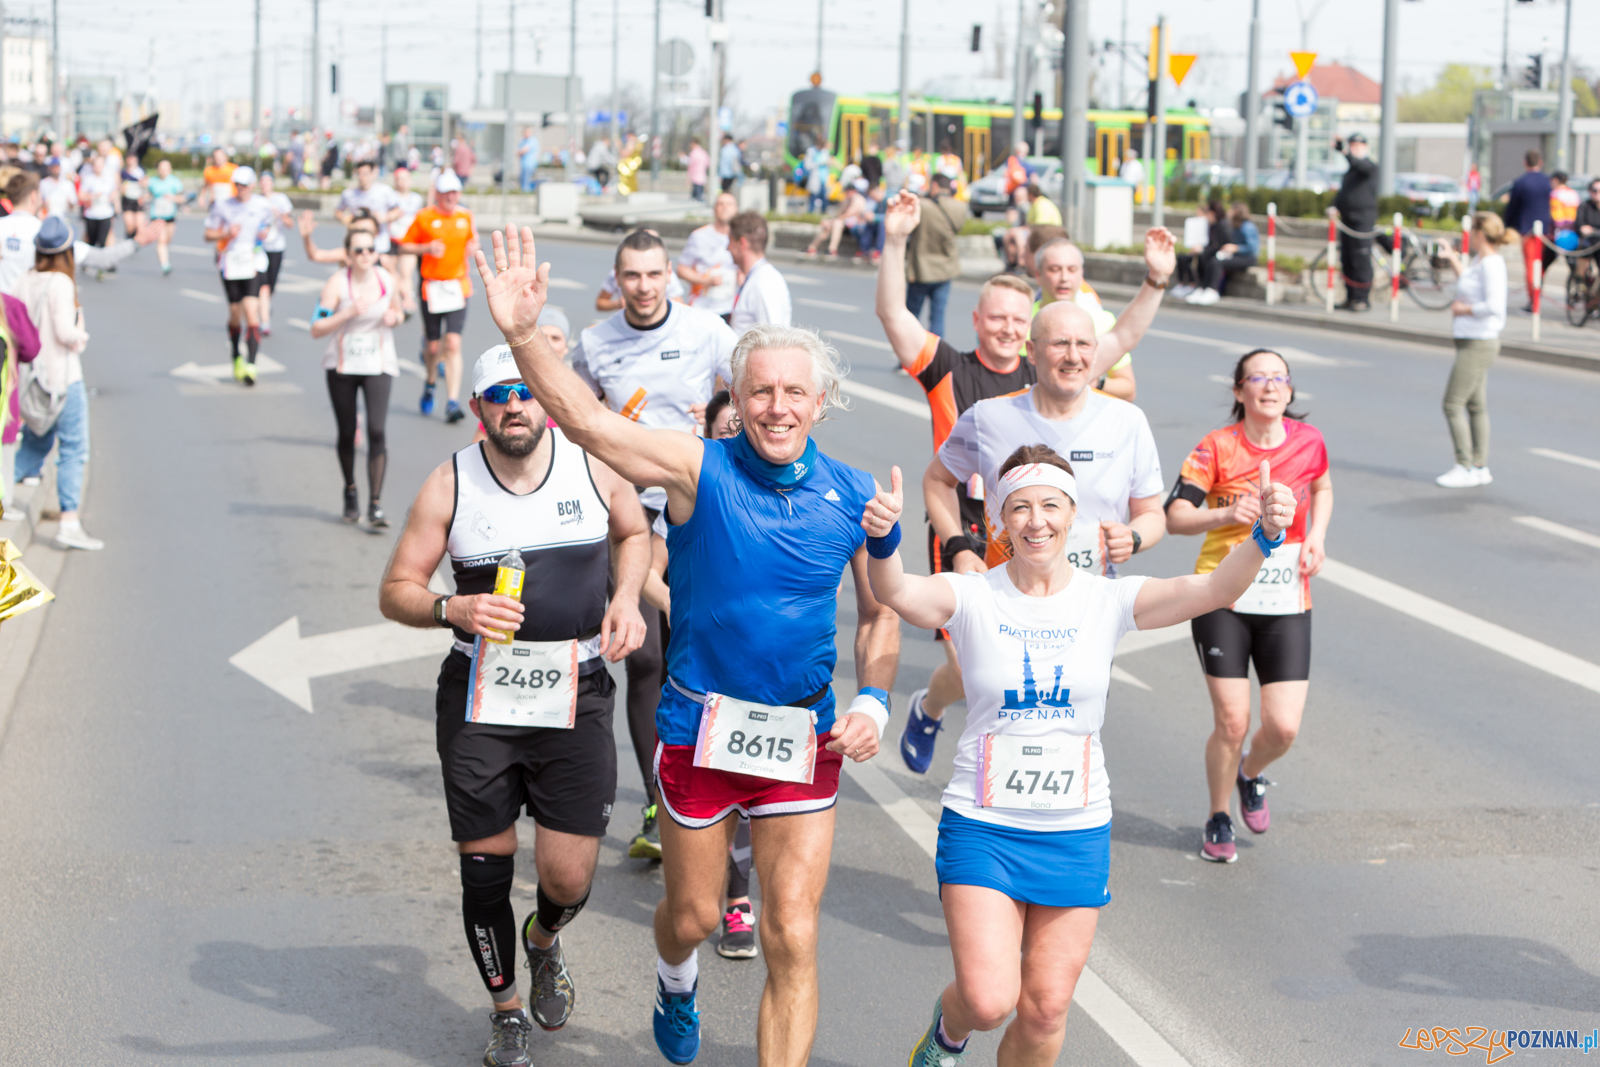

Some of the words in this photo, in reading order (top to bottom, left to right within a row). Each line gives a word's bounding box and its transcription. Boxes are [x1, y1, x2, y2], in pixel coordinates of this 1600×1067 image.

[557, 499, 582, 516] BCM
[1253, 568, 1292, 584] 220
[494, 666, 562, 688] 2489
[516, 693, 538, 701] Jacek
[998, 708, 1075, 721] POZNAŃ
[727, 730, 794, 762] 8615
[739, 761, 776, 774] Zbigniew
[1005, 770, 1075, 794] 4747
[1030, 801, 1052, 809] Ilona
[475, 926, 498, 978] COMPRESPORT
